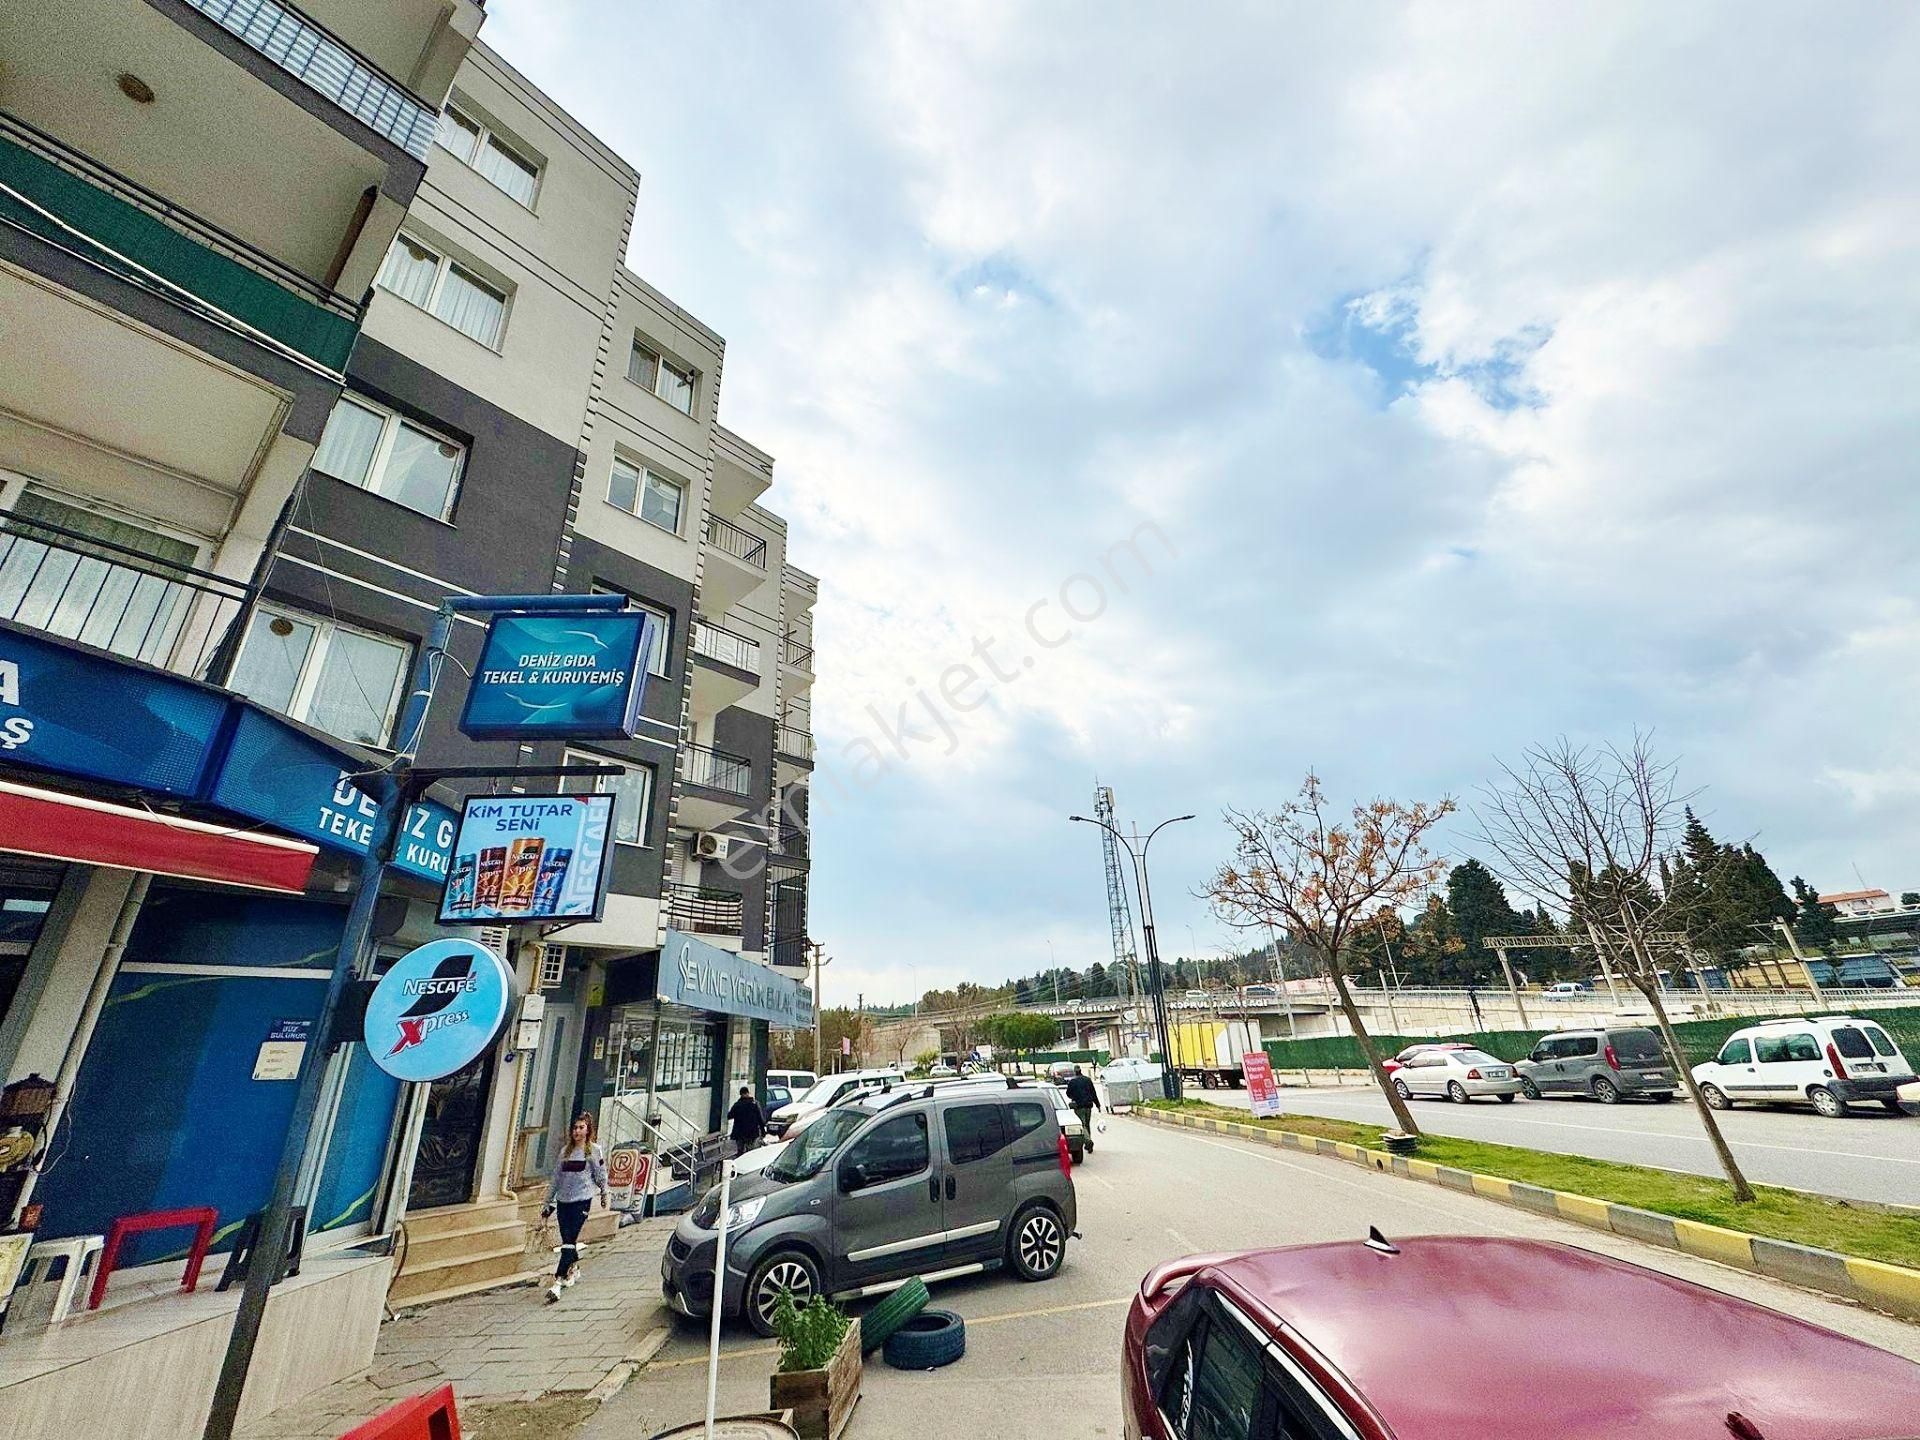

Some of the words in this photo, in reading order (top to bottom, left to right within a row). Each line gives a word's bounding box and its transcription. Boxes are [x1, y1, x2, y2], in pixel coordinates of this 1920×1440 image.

[519, 652, 561, 667] DENİZ
[564, 654, 596, 667] GIDA
[483, 671, 524, 684] TEKEL
[528, 671, 539, 684] &
[542, 668, 624, 687] KURUYEMİŞ
[468, 805, 502, 818] KİM
[511, 804, 573, 817] TUTAR
[319, 806, 374, 846] TEKE
[496, 818, 540, 831] SENİ
[402, 971, 477, 996] NESCAFÉ
[383, 1010, 469, 1060] Xpress
